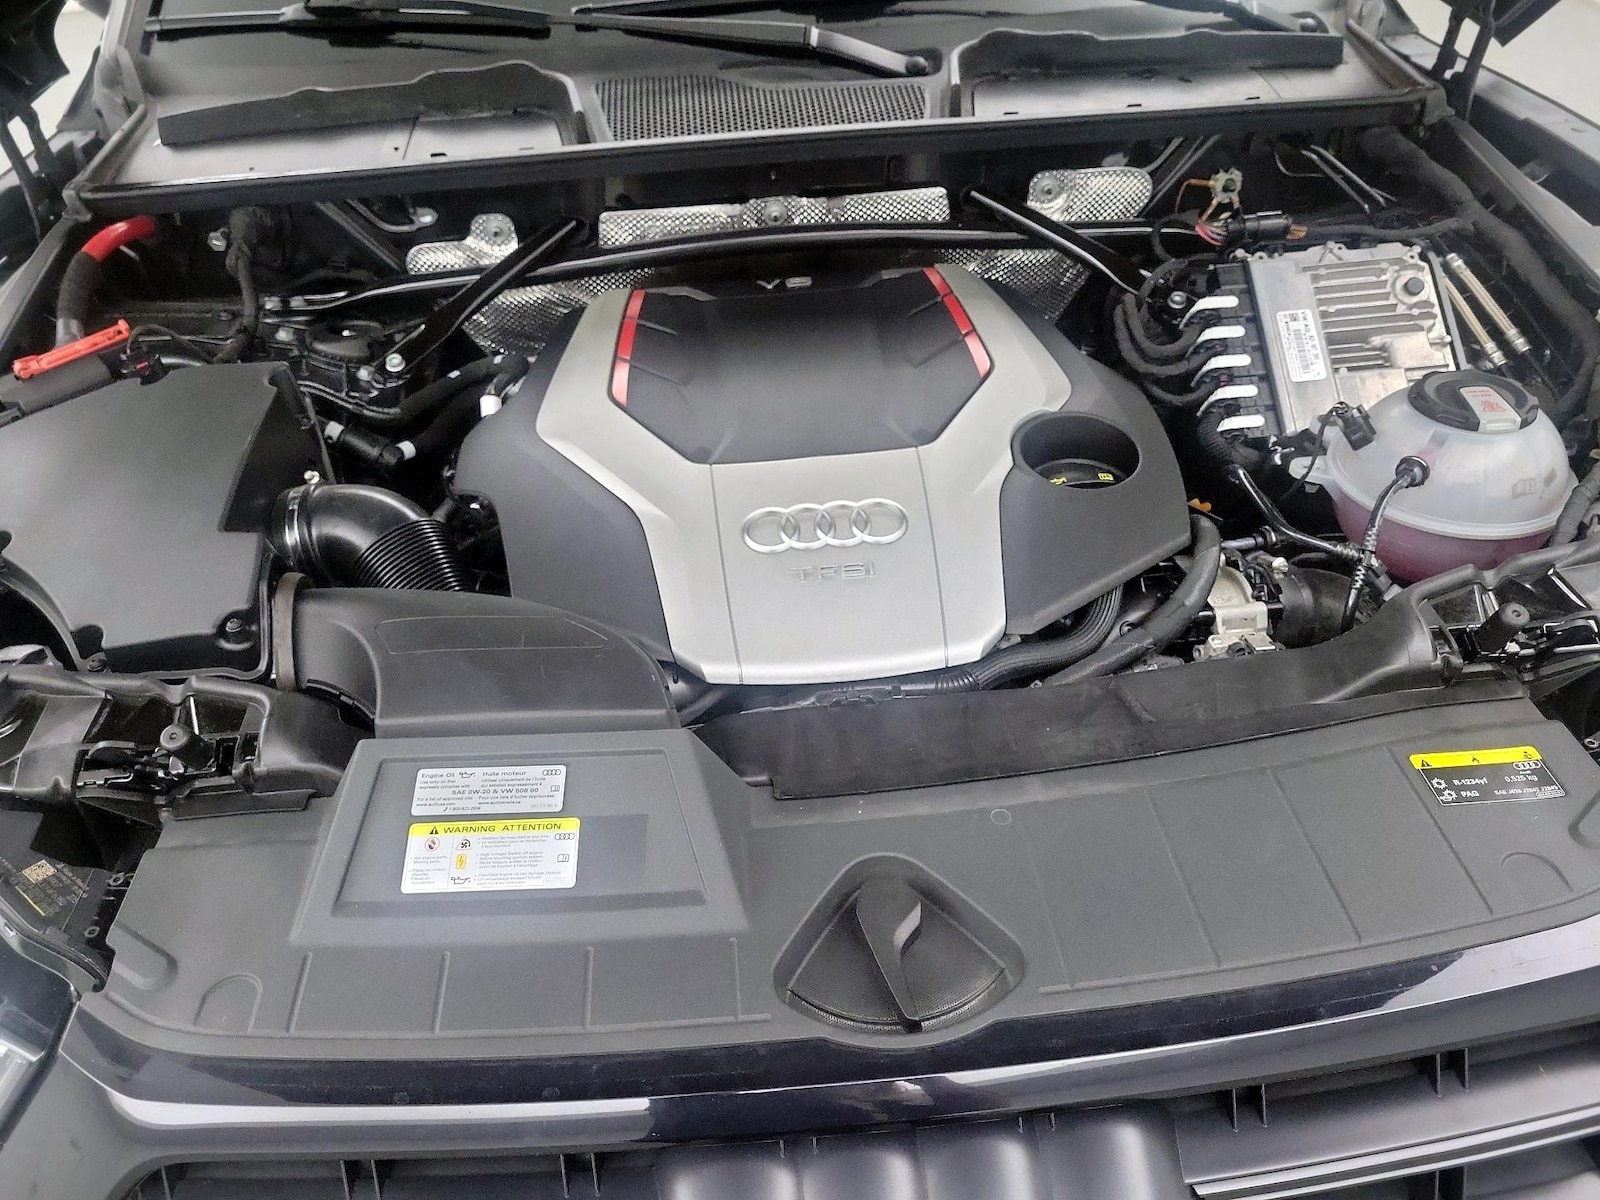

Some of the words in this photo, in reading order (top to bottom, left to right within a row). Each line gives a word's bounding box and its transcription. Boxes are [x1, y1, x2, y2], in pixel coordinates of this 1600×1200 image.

[755, 276, 813, 290] V6
[787, 561, 876, 584] TFSI
[1460, 790, 1480, 798] PAG
[443, 825, 496, 833] WARNING
[502, 823, 561, 832] ATTENTION
